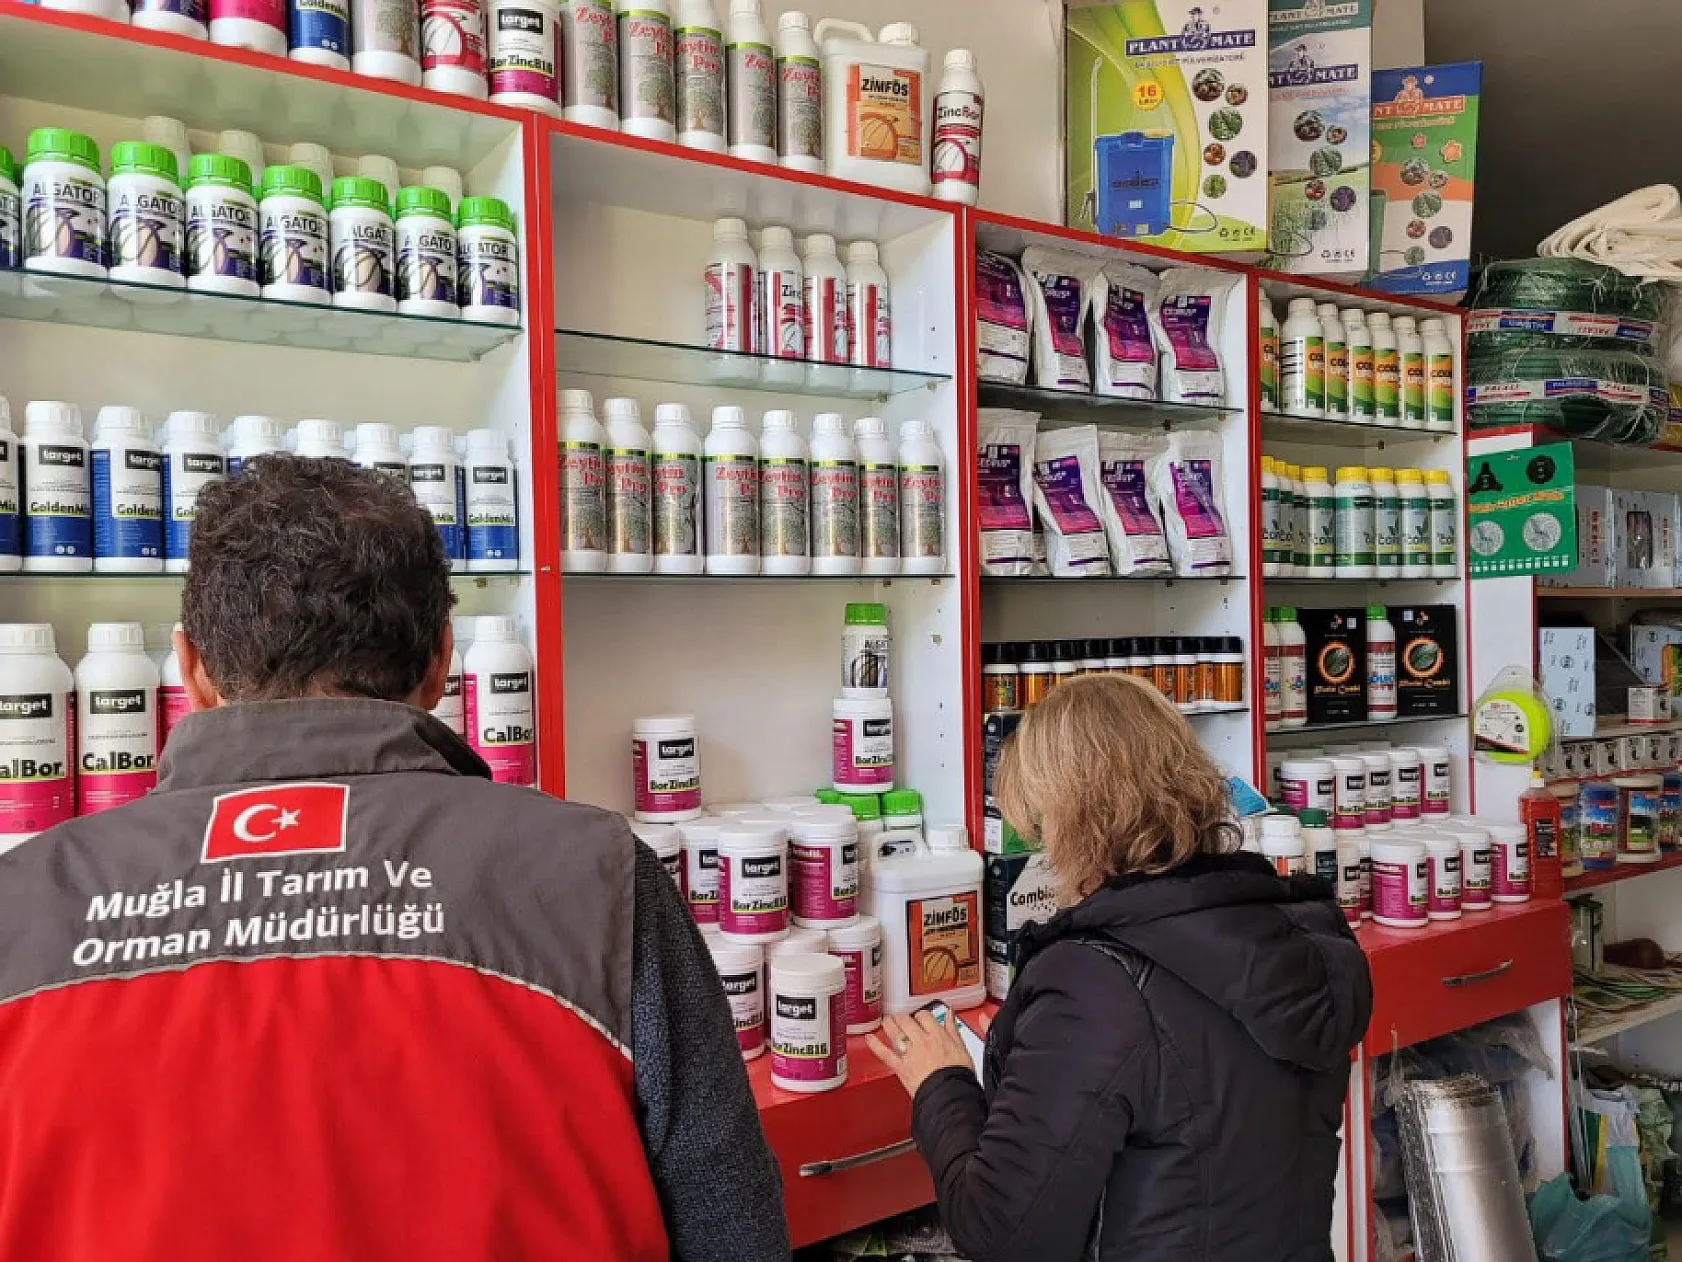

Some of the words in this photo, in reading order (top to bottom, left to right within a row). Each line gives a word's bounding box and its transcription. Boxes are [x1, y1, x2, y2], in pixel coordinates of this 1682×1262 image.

[1129, 40, 1179, 54] PLANT
[1210, 32, 1255, 47] MATE
[95, 694, 141, 709] target
[0, 757, 62, 779] alBor
[82, 750, 155, 771] CalBor
[744, 862, 780, 876] target
[86, 879, 206, 922] Muğla
[220, 867, 243, 903] İl
[256, 865, 369, 897] Tarım
[383, 860, 432, 888] Ve
[72, 928, 212, 967] Orman
[223, 902, 445, 947] Müdürlüğü
[778, 1000, 813, 1018] target
